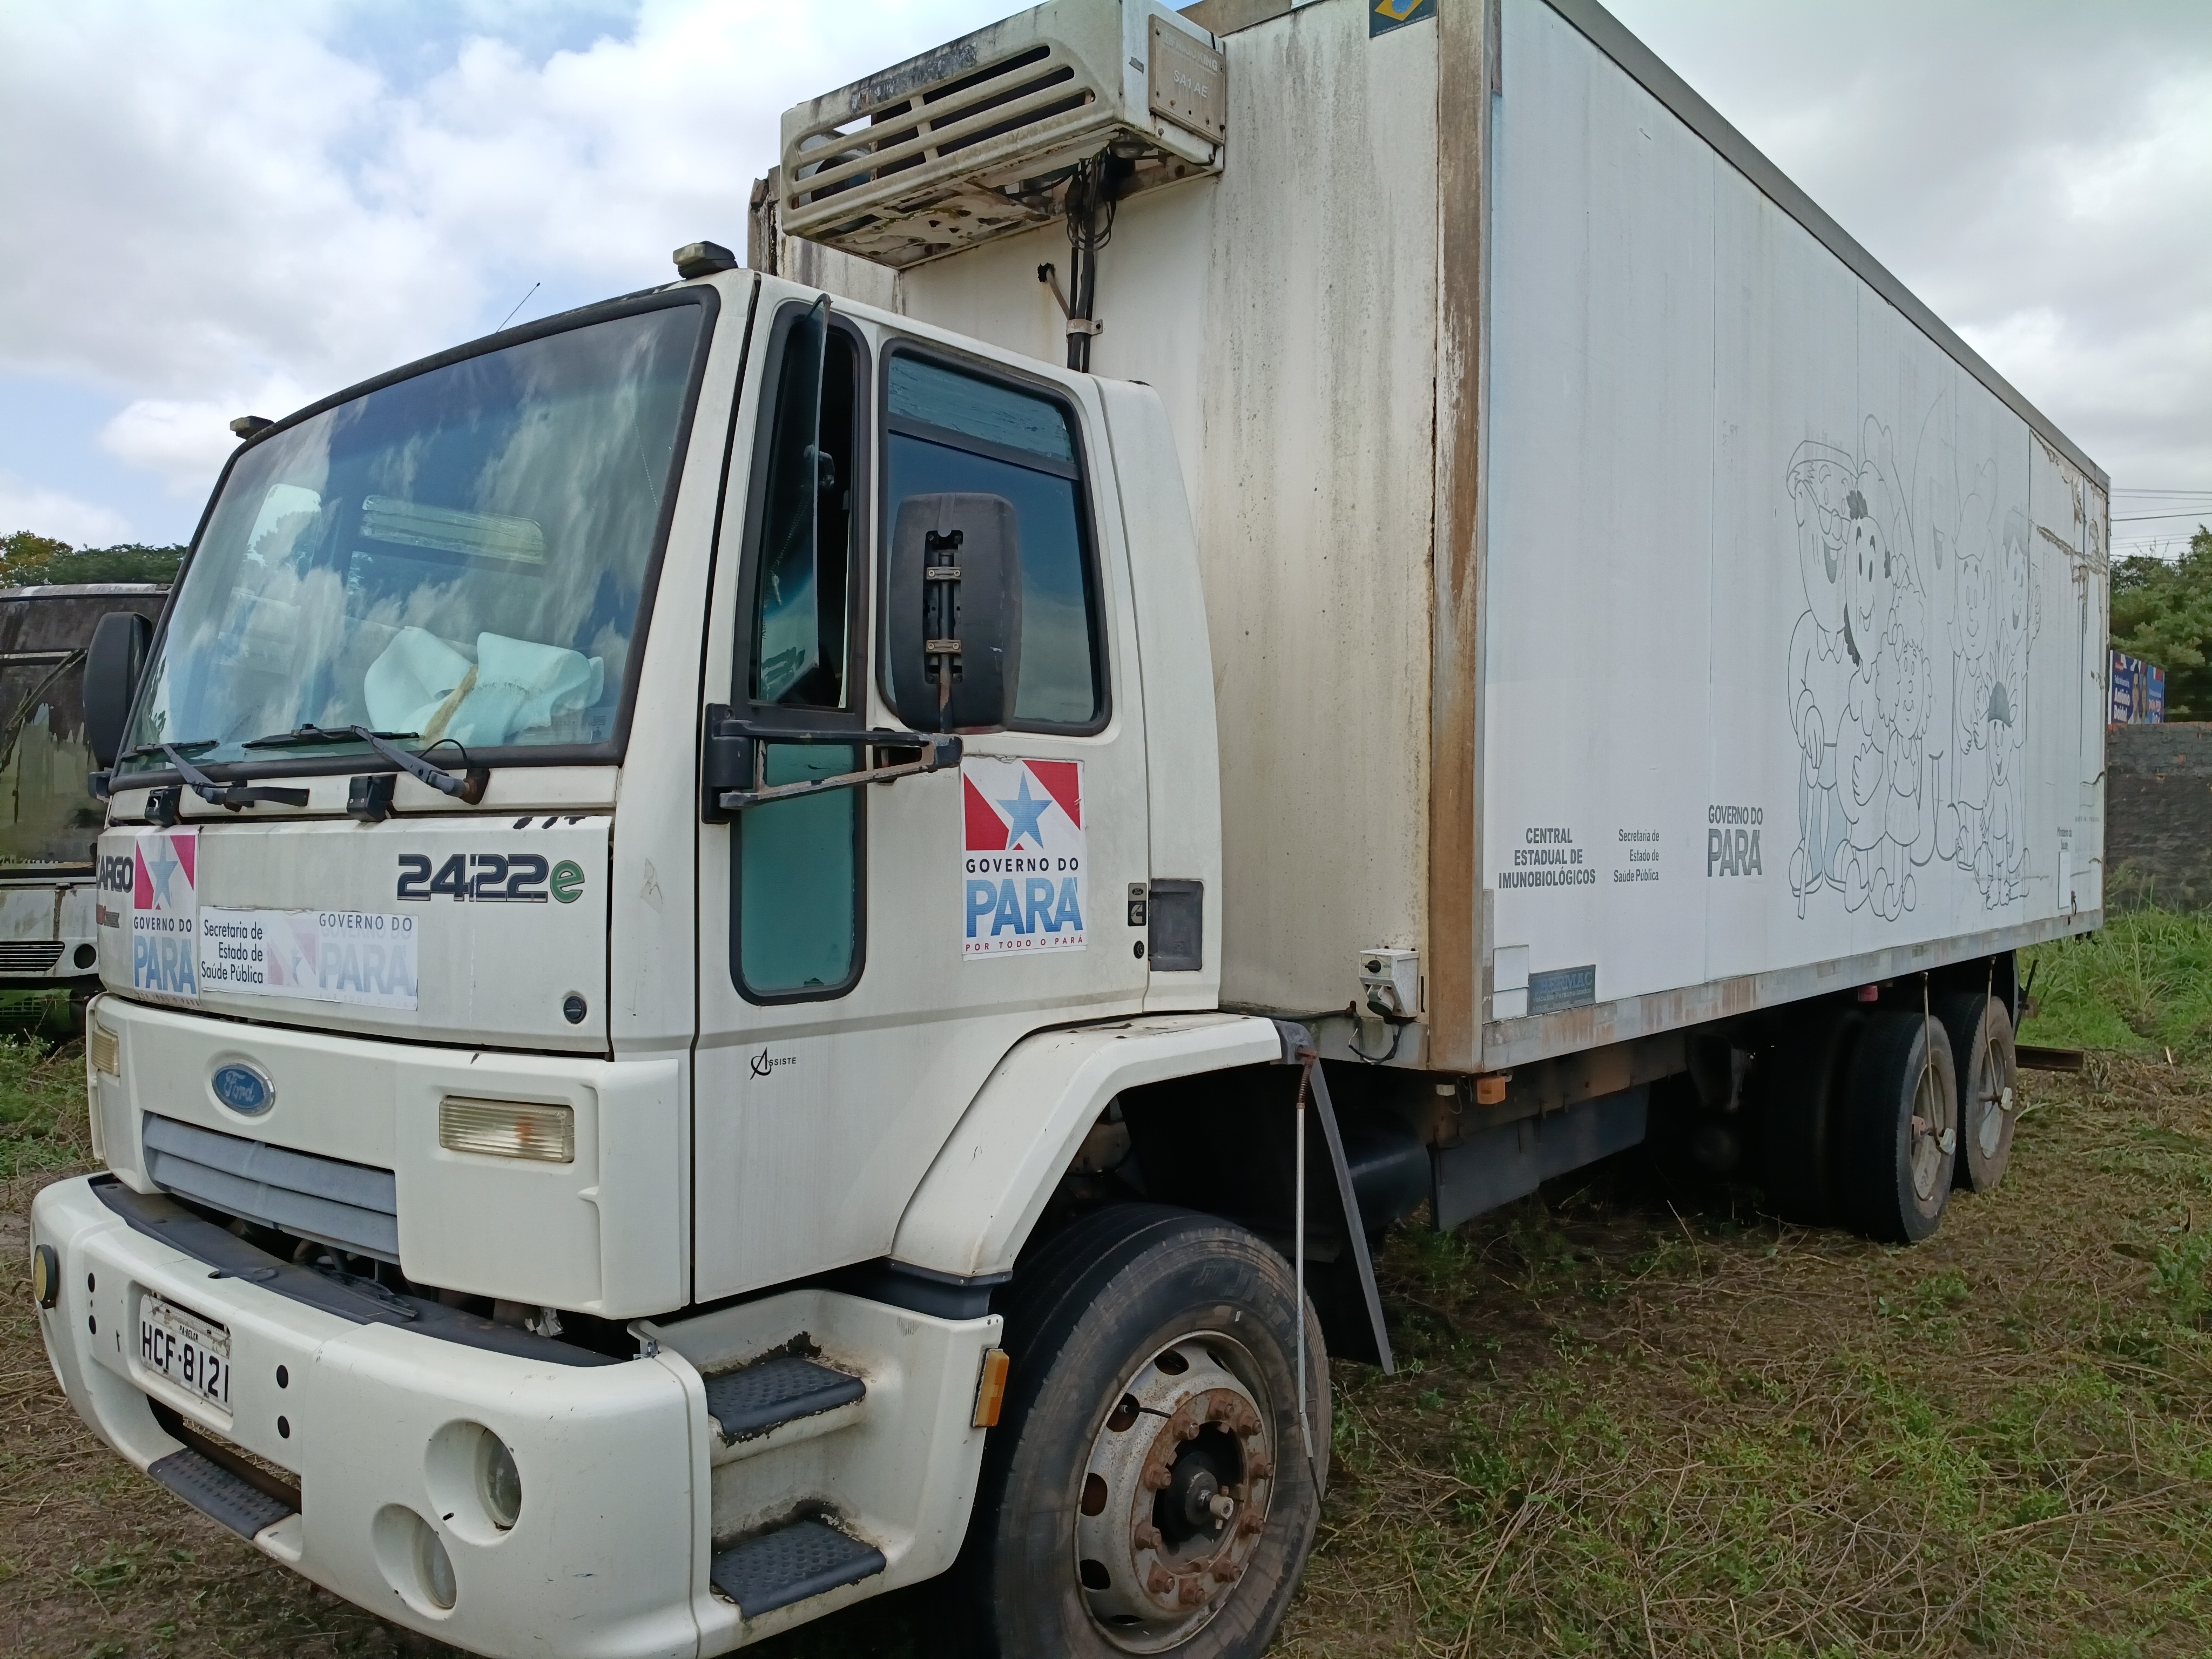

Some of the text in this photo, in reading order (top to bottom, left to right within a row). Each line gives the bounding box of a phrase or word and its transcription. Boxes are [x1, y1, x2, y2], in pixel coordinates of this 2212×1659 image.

[1173, 70, 1192, 89] SA1
[1193, 82, 1208, 98] AE
[1708, 805, 1763, 825] GOVERNO DO
[1526, 827, 1573, 844] CENTRAL
[1618, 828, 1660, 841] Secretaria de
[1514, 849, 1583, 866] ESTADUAL DE
[1629, 849, 1659, 861] Estado de
[966, 858, 1078, 873] GOVERNO DO
[1499, 866, 1596, 889] IMUNOBIOLÓGICOS
[1614, 868, 1659, 882] Saúde Pública
[134, 916, 192, 933] GOVERNO DO
[204, 919, 263, 940] Secretaria de
[319, 913, 412, 932] GOVERNO DO
[219, 941, 263, 962] Estado de
[966, 942, 989, 952] POR
[999, 940, 1031, 949] TODO
[1055, 934, 1083, 945] PARÁ
[201, 961, 263, 984] Saúde Pública
[1555, 987, 1592, 1000] Personalizados
[224, 1070, 255, 1103] Ford
